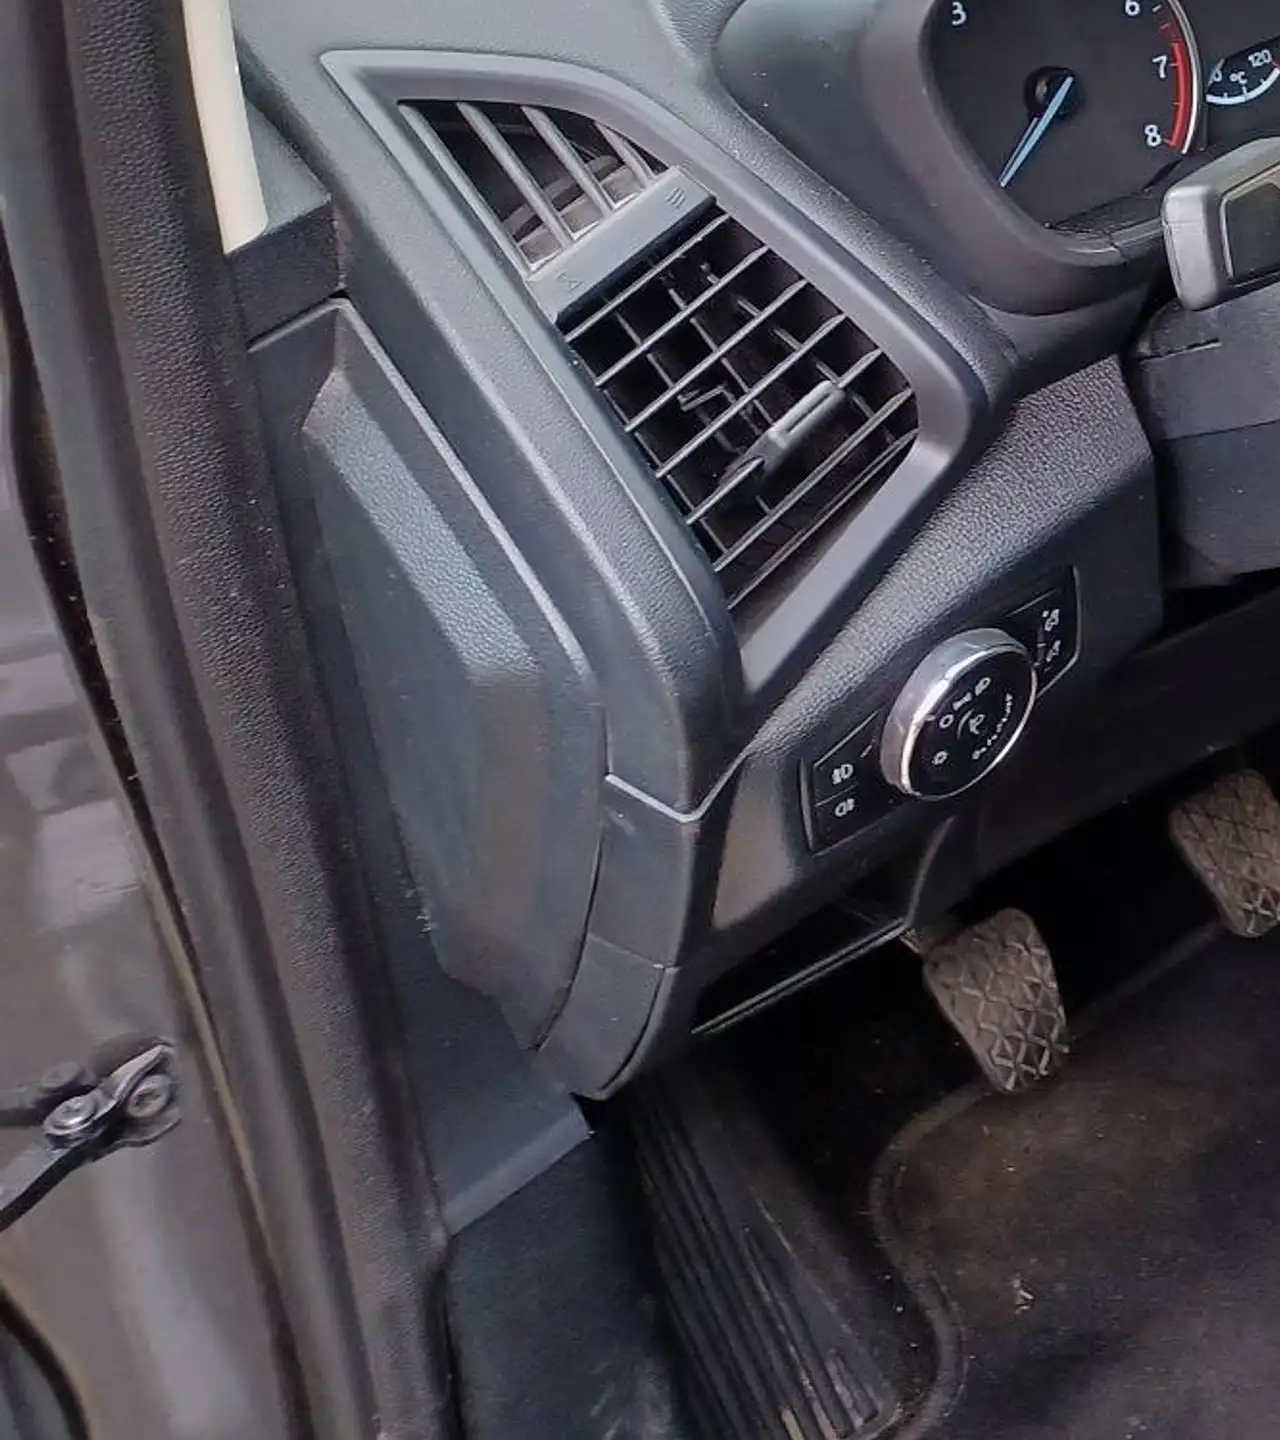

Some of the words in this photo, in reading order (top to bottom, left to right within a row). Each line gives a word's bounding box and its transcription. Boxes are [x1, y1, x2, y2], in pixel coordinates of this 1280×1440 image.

[951, 1, 968, 25] 3
[1151, 55, 1168, 79] 7
[1248, 49, 1272, 68] 120
[1144, 124, 1162, 148] 8
